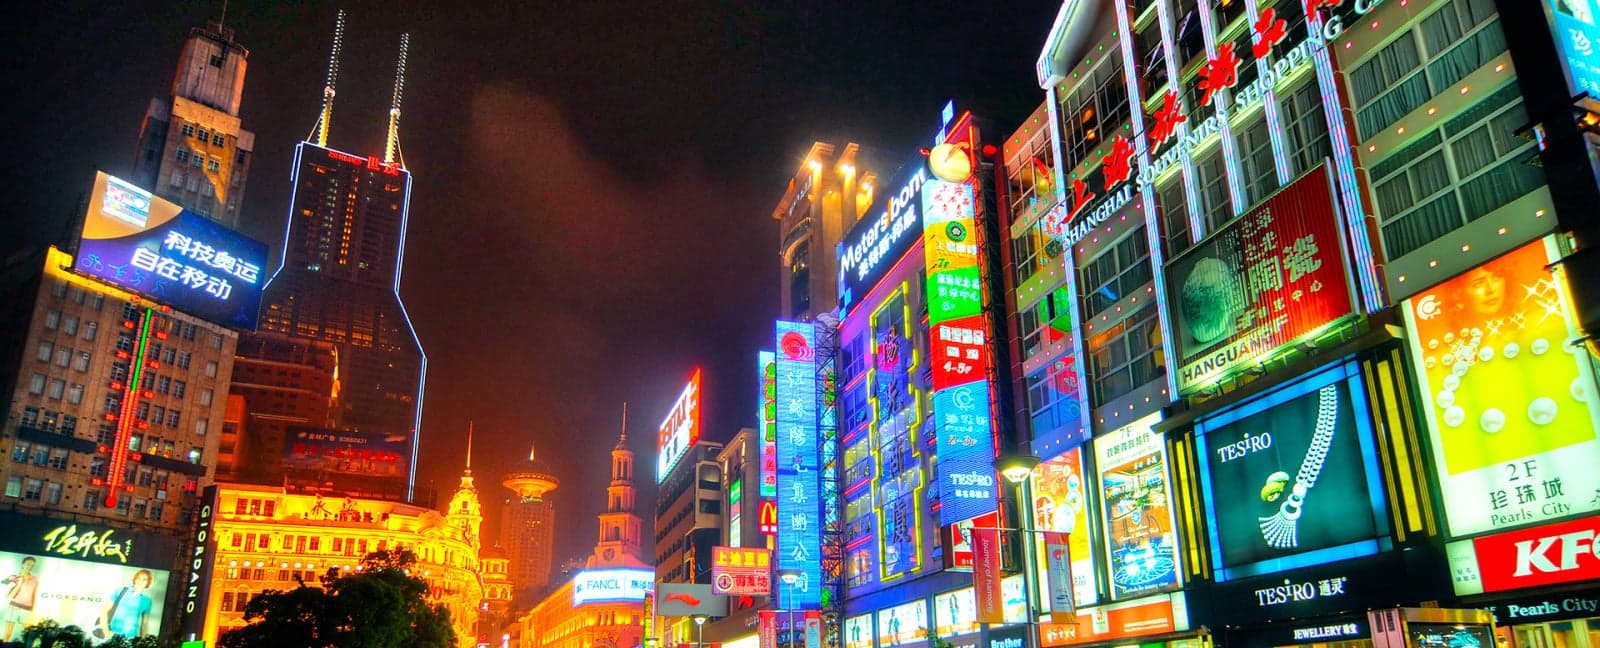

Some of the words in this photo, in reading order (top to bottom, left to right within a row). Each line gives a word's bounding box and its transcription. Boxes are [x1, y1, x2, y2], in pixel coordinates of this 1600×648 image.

[1063, 0, 1344, 224] 上海旅游品
[1063, 184, 1133, 246] SHANGHAI
[1135, 110, 1229, 192] SOUVENIRS
[1235, 15, 1343, 111] SHOPPING
[131, 247, 233, 300] 自在移动
[164, 230, 260, 284] 科技奥运
[1489, 476, 1564, 511] 珍珠城
[1491, 508, 1533, 526] Pearls
[1541, 502, 1572, 516] City
[186, 505, 211, 614] GIORDANO
[1513, 529, 1600, 577] KF
[41, 592, 102, 603] GIORDANO
[586, 579, 621, 590] FANCL
[1507, 601, 1560, 618] Pearls
[1562, 598, 1598, 612] City
[991, 637, 1024, 648] Brother
[1294, 624, 1341, 640] JEWELLERY
